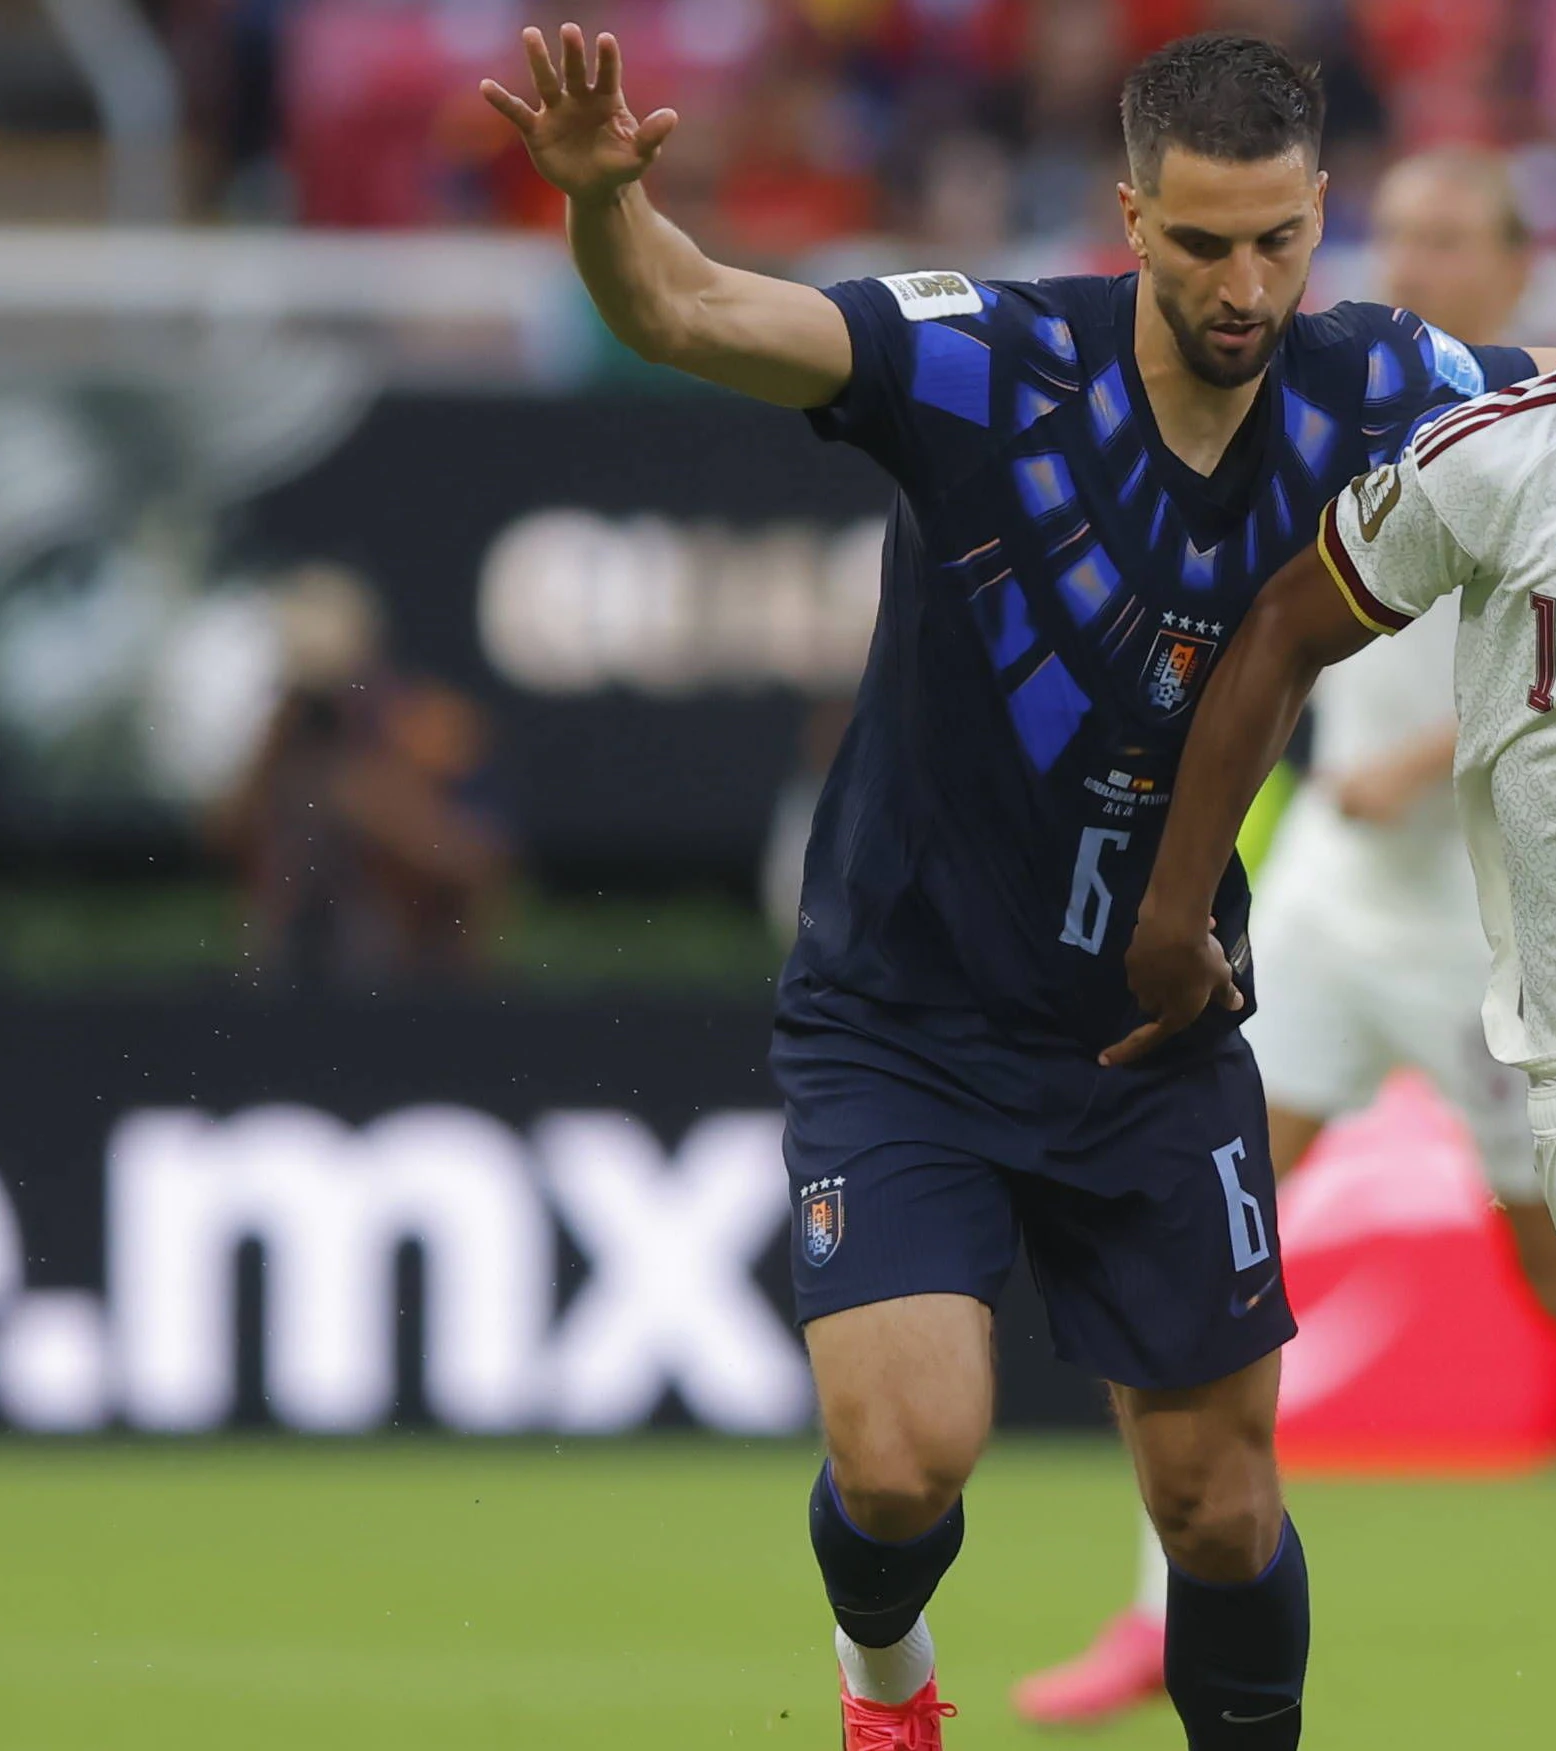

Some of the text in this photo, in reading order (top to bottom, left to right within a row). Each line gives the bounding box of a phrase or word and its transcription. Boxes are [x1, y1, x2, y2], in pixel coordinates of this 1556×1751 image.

[1059, 826, 1131, 956] 6
[0, 1106, 812, 1430] .mx
[1211, 1136, 1271, 1272] 6
